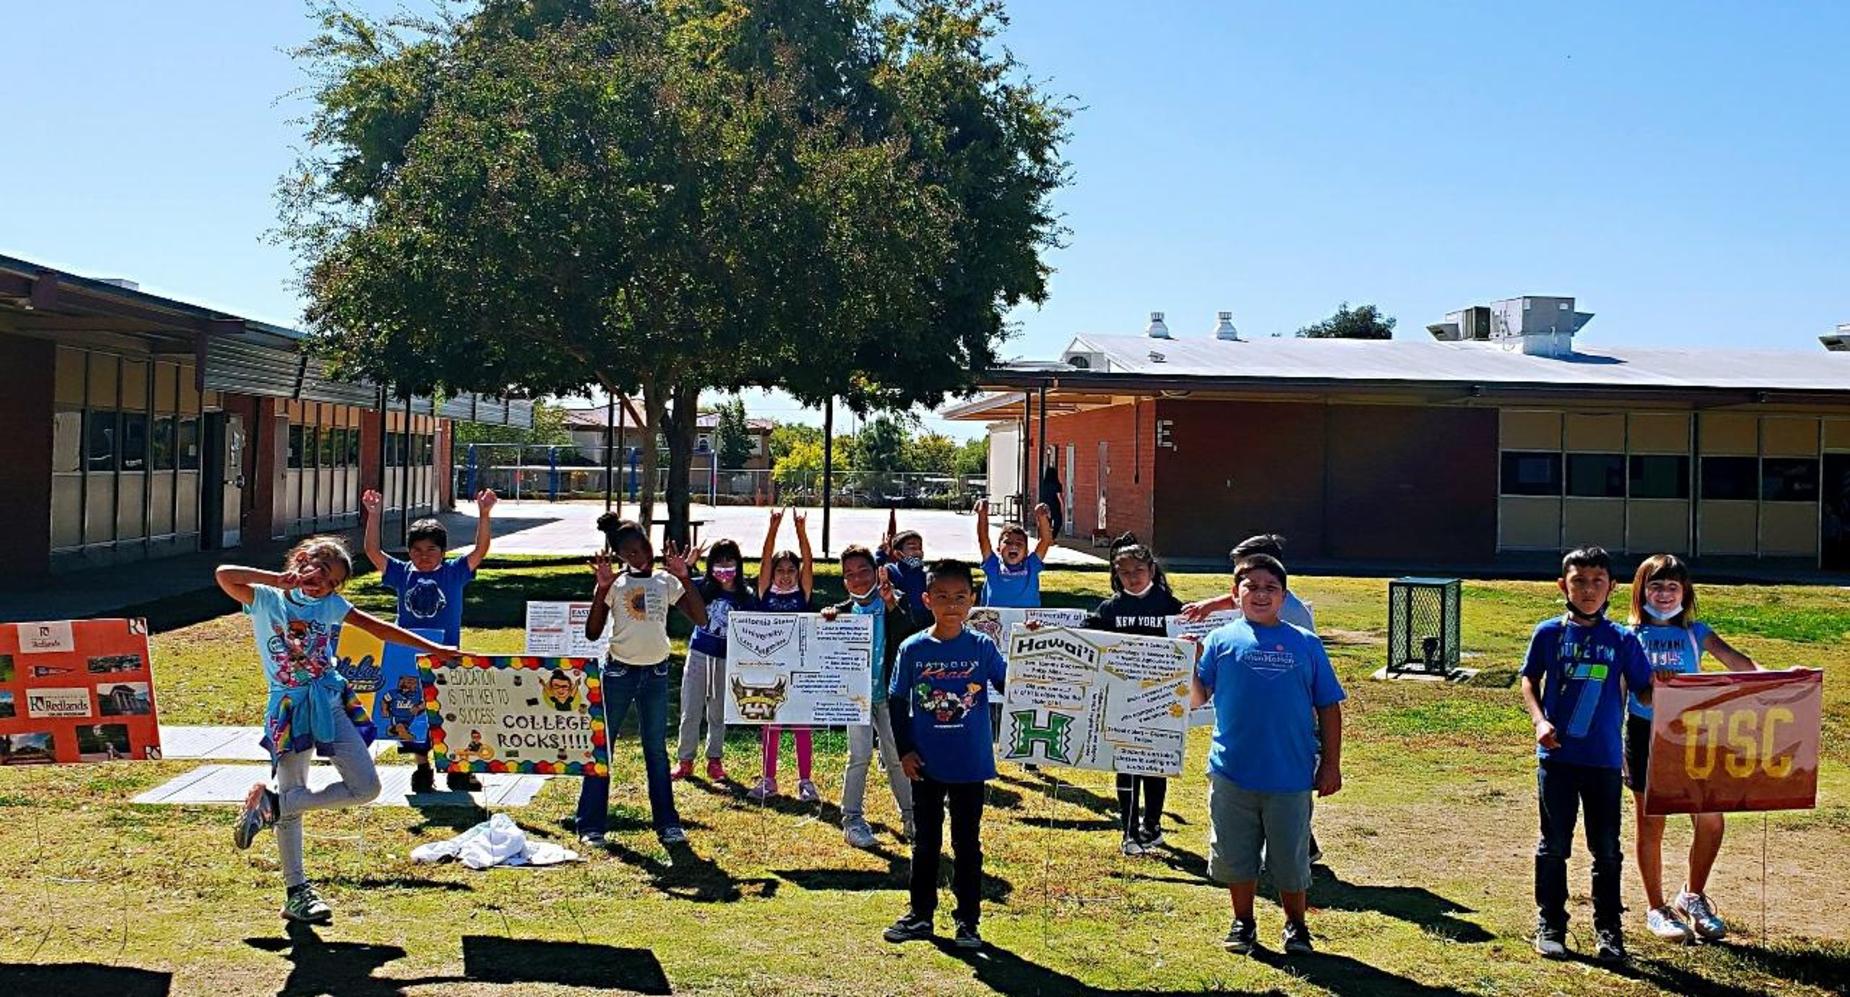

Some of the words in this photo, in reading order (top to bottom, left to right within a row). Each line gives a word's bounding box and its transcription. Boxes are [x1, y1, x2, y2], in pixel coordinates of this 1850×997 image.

[1115, 616, 1136, 628] NEW
[1138, 616, 1163, 628] YORK
[450, 669, 496, 686] EDUCATION
[497, 688, 510, 705] TO
[46, 699, 88, 712] Redlands
[459, 707, 497, 725] SUCCESS
[502, 714, 591, 731] COLLEGE
[497, 733, 590, 750] ROCKS!!!!
[1682, 708, 1795, 780] USC
